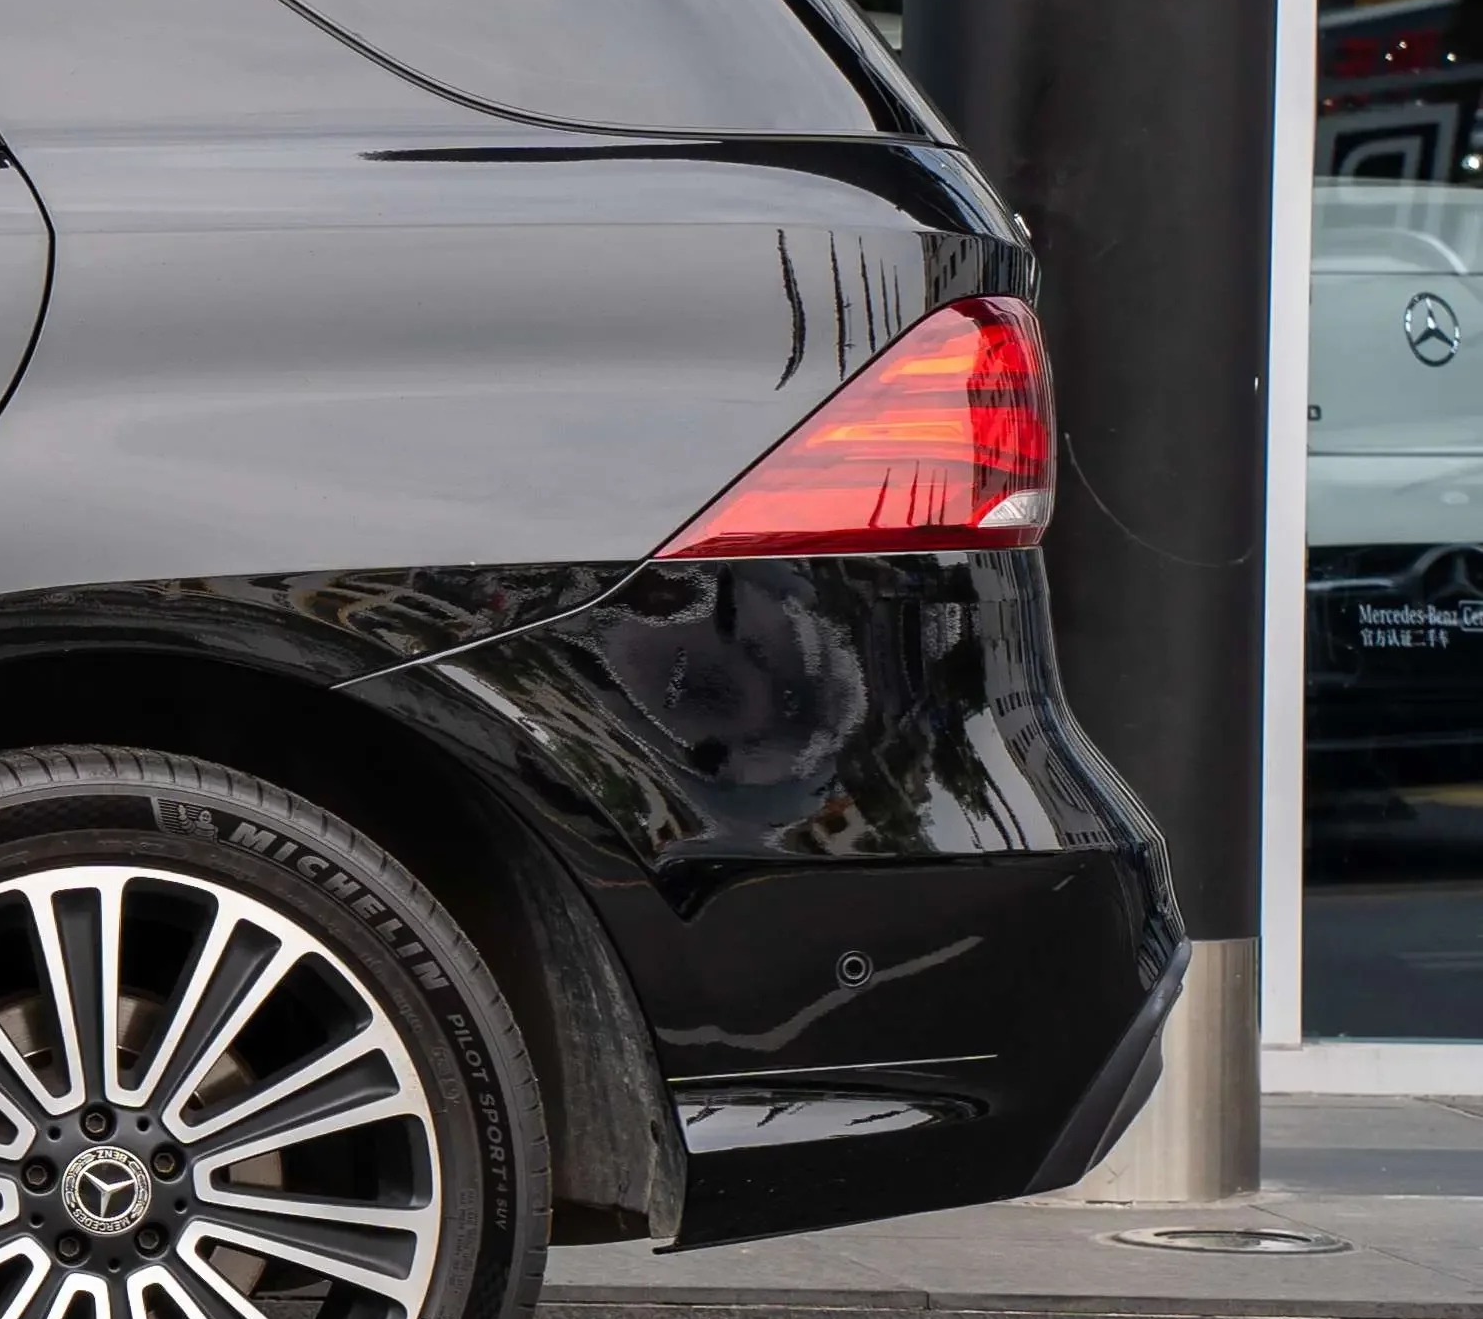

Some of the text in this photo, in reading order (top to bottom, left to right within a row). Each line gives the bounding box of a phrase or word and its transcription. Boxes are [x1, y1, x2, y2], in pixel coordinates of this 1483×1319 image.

[1358, 604, 1458, 626] Mercedes-Benz
[228, 822, 451, 991] MICHELIN
[446, 1013, 490, 1084] PILOT
[480, 1091, 510, 1179] SPORT
[96, 1149, 128, 1163] BENZ
[72, 1208, 132, 1232] MERCEDES
